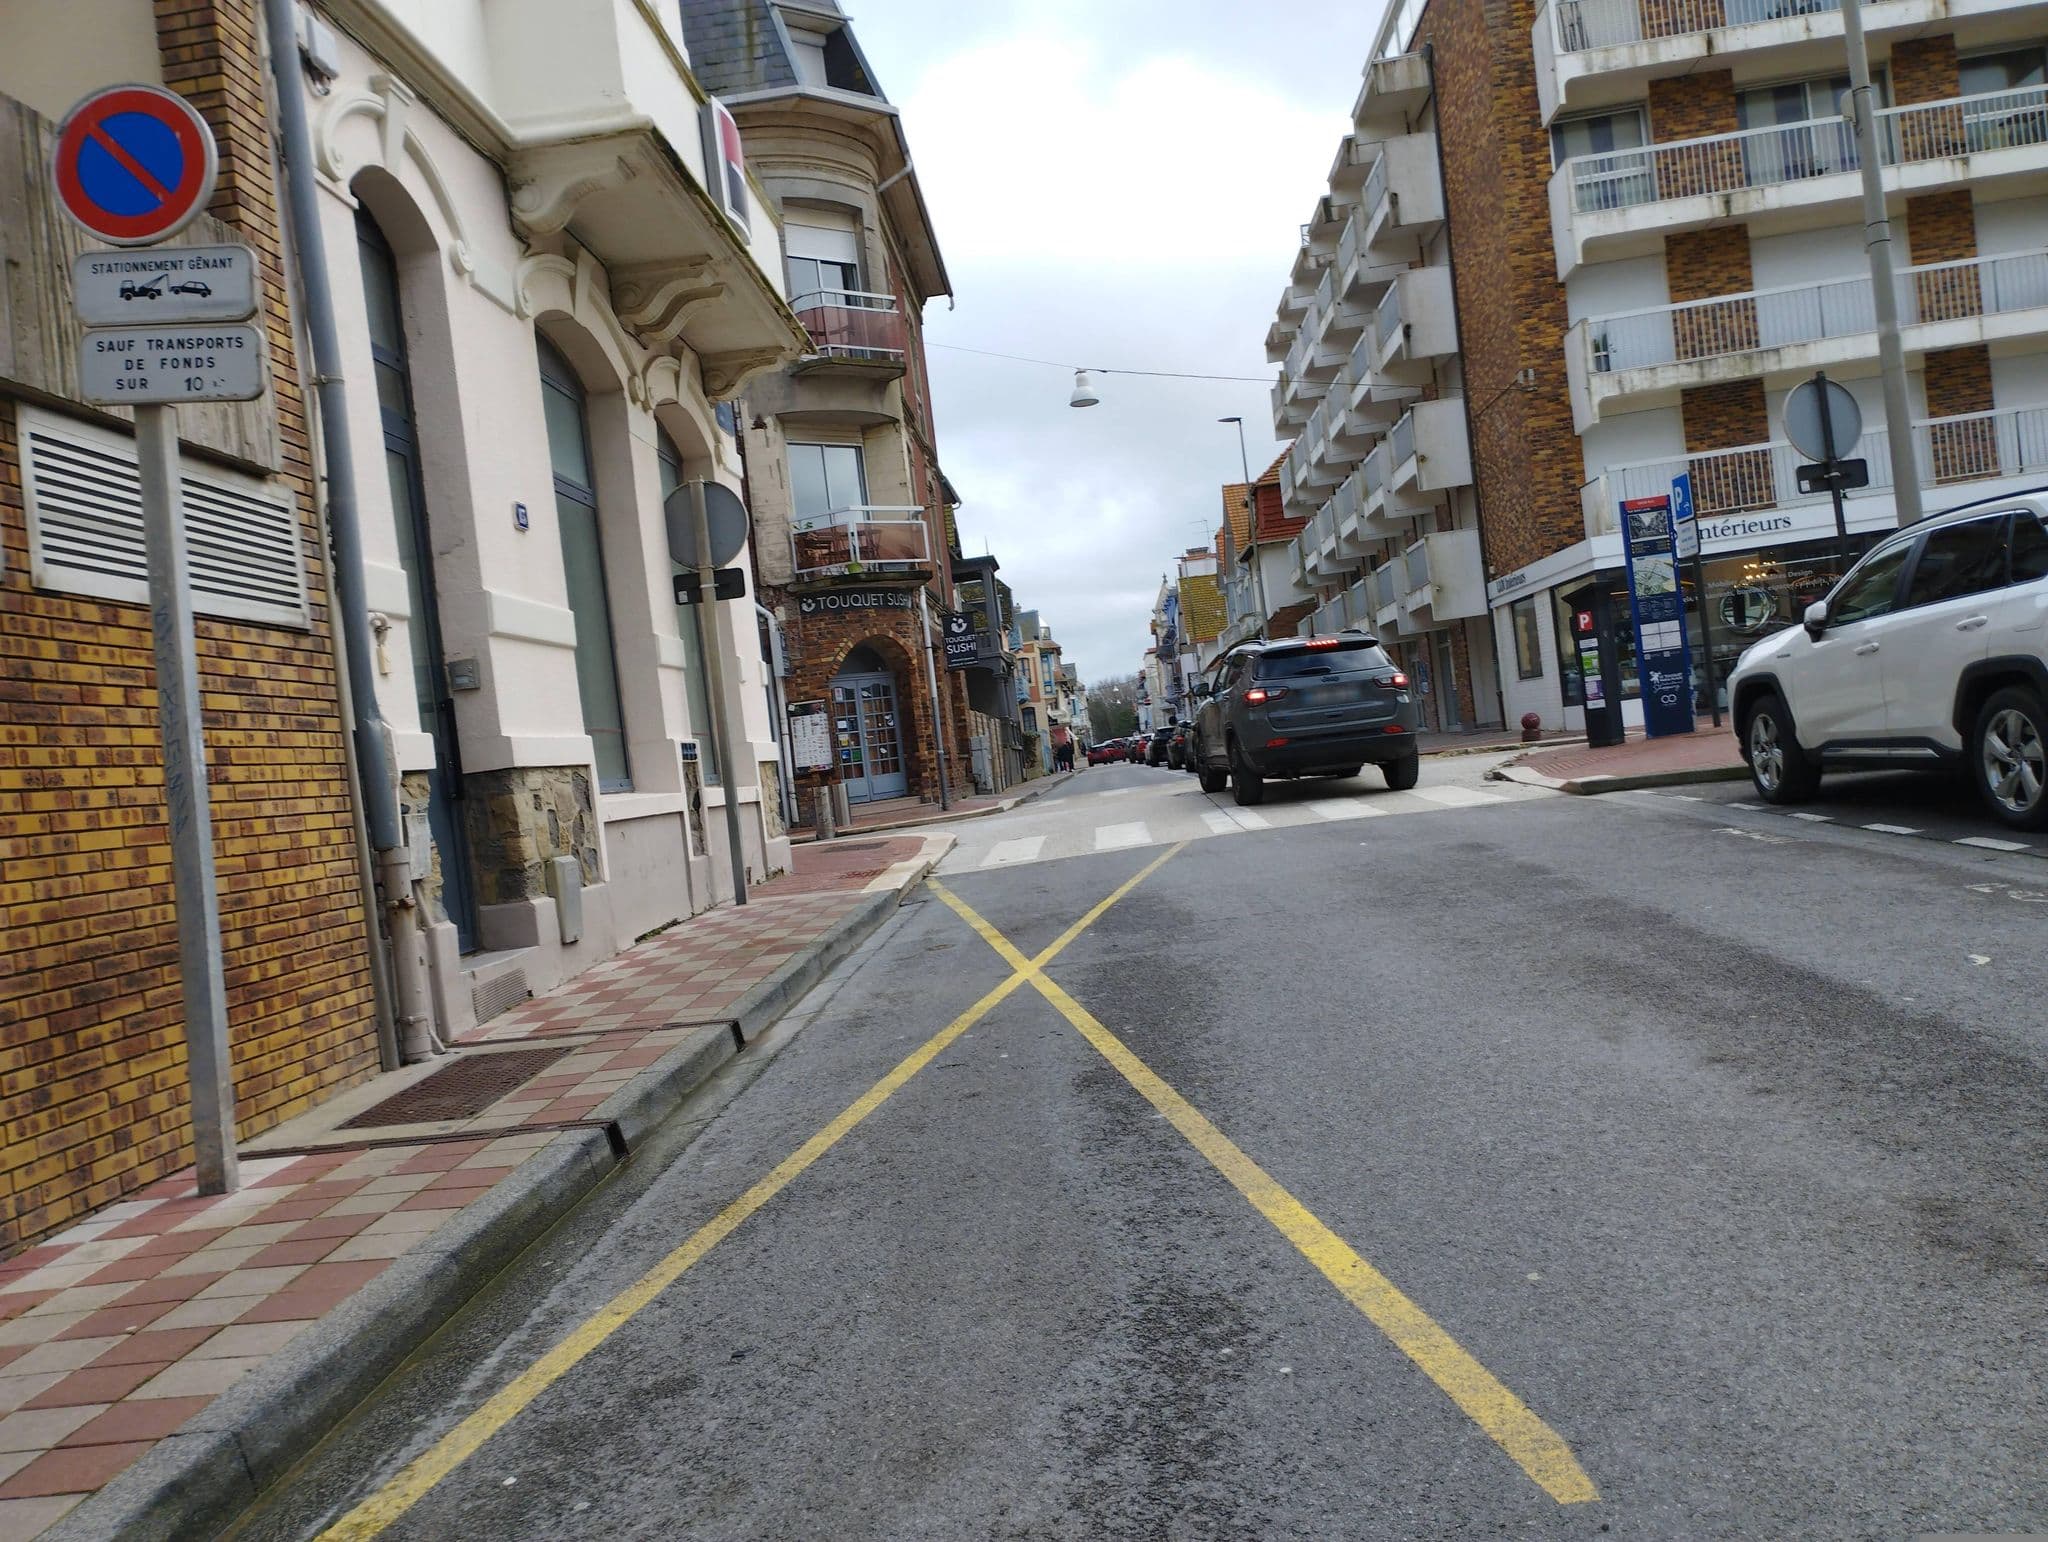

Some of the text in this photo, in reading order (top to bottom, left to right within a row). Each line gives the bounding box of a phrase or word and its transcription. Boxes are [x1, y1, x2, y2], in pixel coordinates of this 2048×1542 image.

[91, 256, 233, 275] STATIONNEMENT GÊNANT
[96, 336, 244, 352] SAUF TRANSPORTS
[125, 356, 216, 371] DE FONDS
[116, 378, 149, 390] SUR
[184, 376, 204, 391] 10
[1674, 486, 1683, 511] P
[1698, 516, 1792, 540] ntérieurs
[817, 593, 884, 610] TOUQUET
[1579, 614, 1590, 629] P
[945, 634, 976, 644] TOUQUET
[946, 641, 977, 654] SUSHI
